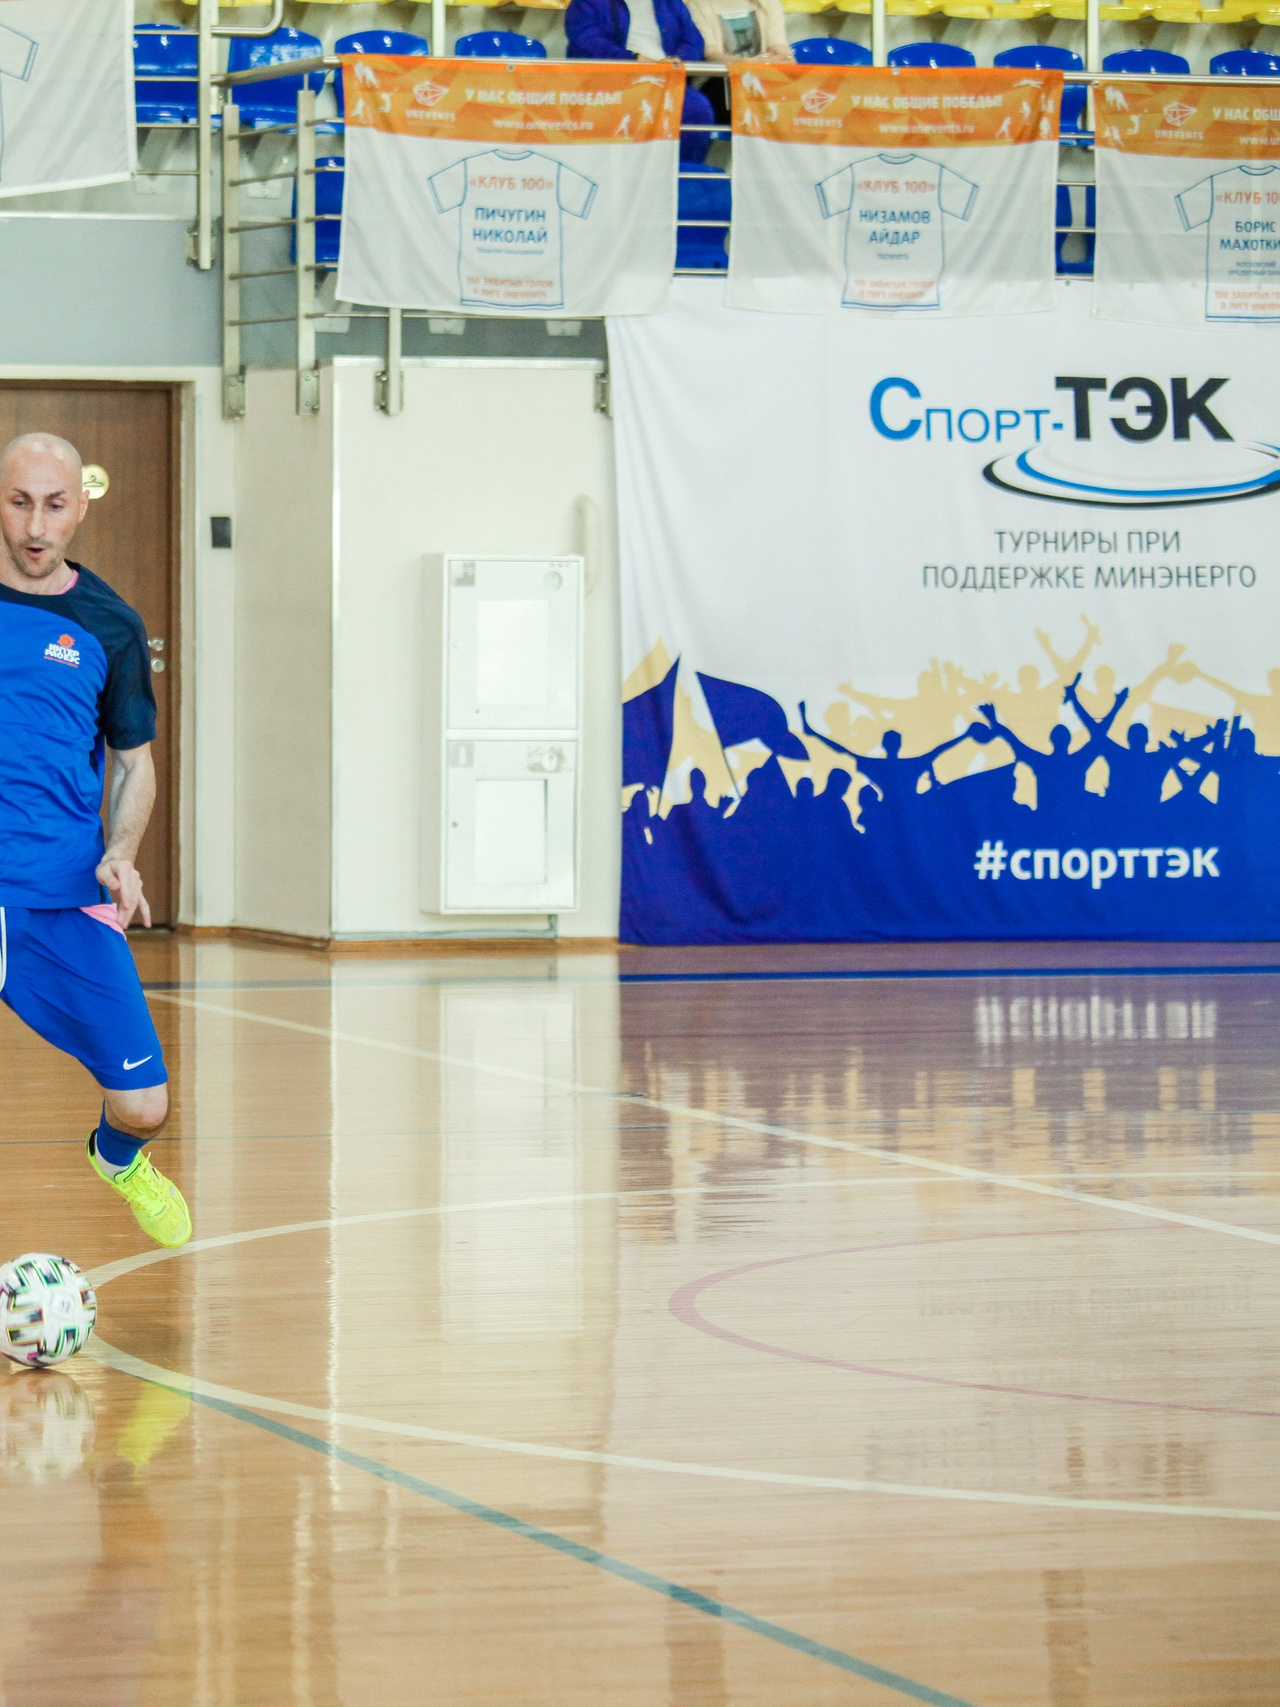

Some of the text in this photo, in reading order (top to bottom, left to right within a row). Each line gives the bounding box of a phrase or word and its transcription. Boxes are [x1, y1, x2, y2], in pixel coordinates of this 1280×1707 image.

[477, 90, 505, 103] НАС
[508, 91, 556, 105] ОБЩИЕ
[469, 176, 554, 191] «КЛУБ 100»
[475, 207, 547, 223] ПИЧУГИН
[859, 210, 931, 224] НИЗАМОВ
[473, 227, 547, 243] НИКОЛАЙ
[1235, 221, 1277, 233] БОРИС
[868, 228, 920, 245] АЙДАР
[994, 531, 1181, 554] ТУРНИРЫ ПРИ
[922, 565, 1256, 592] ПОДДЕРЖКЕ МИНЭНЕРГО
[974, 840, 1220, 890] #спорттэк
